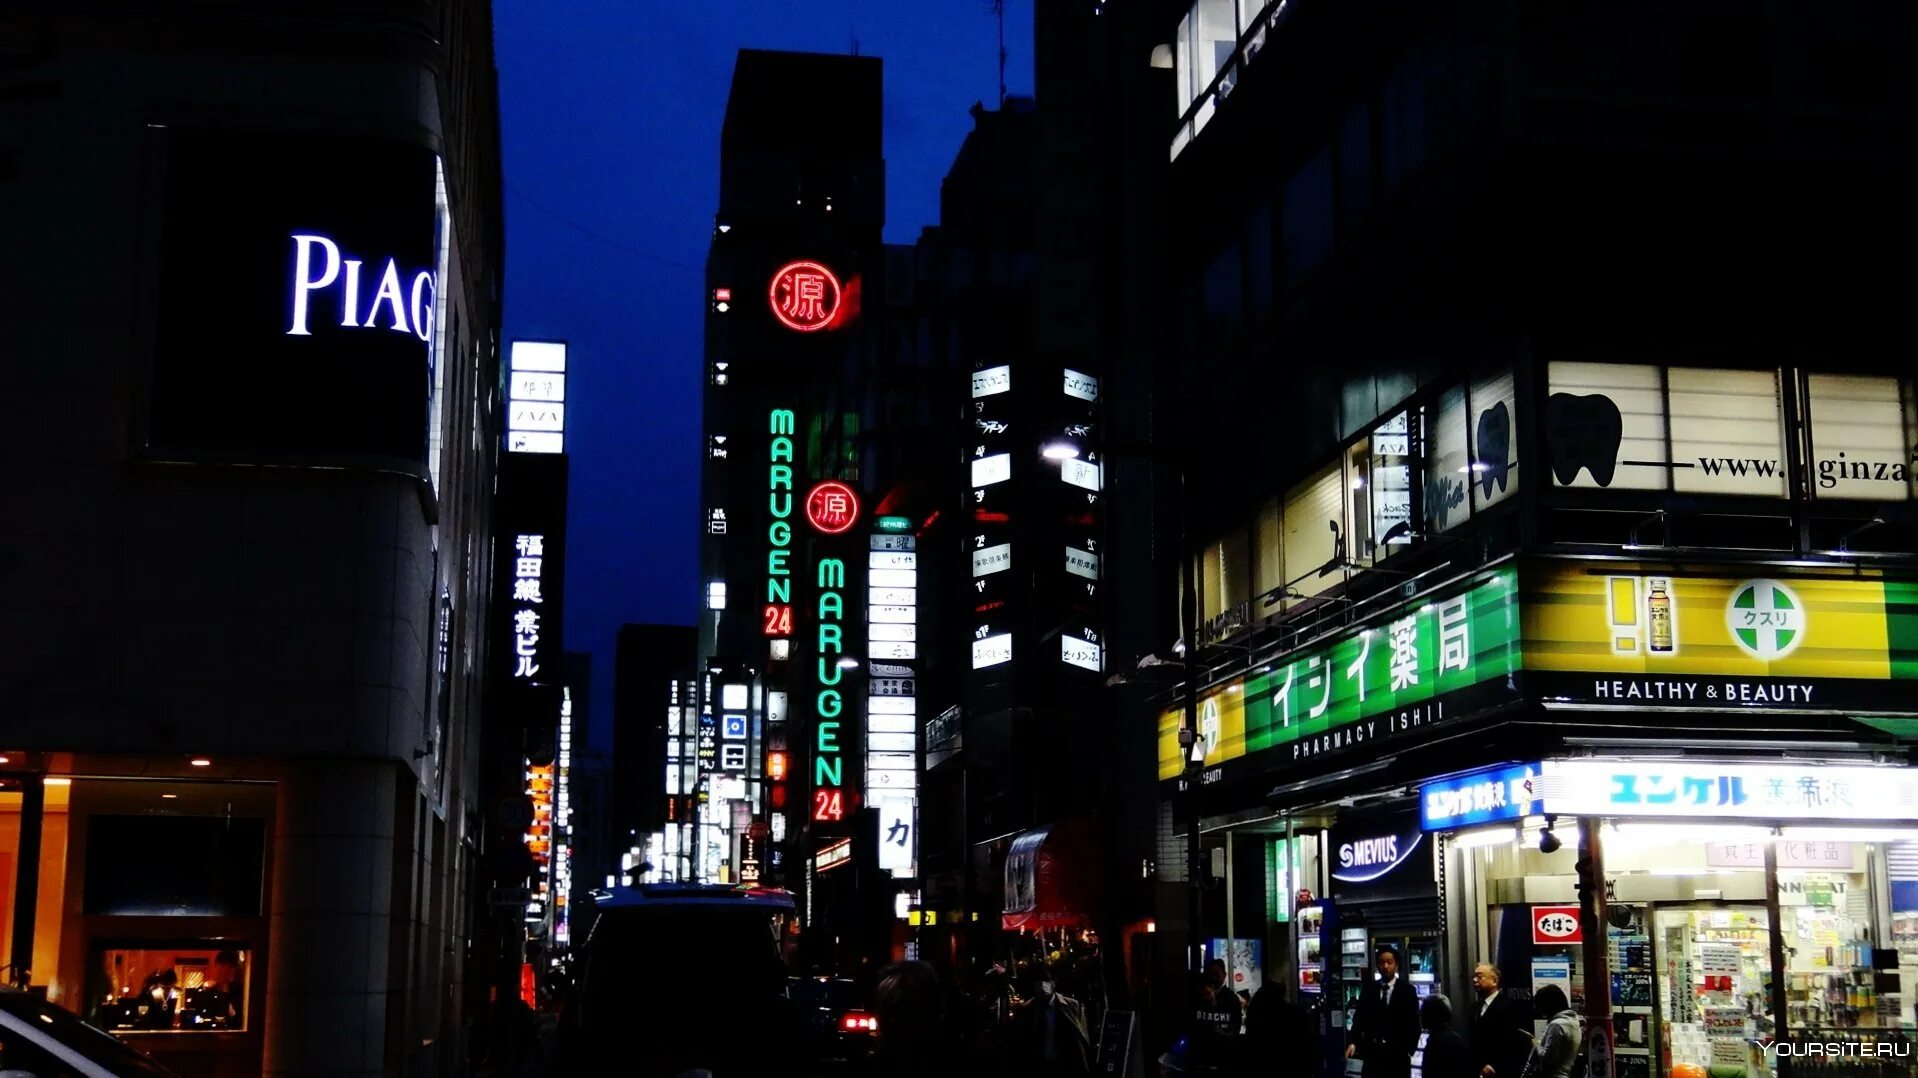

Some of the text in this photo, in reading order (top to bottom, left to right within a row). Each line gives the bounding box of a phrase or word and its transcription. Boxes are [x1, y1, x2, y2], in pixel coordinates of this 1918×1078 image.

[782, 273, 825, 320] 源
[1699, 457, 1785, 479] www.
[1819, 452, 1908, 489] ginza
[765, 409, 794, 634] MARUGEN 24
[815, 492, 848, 524] 源
[974, 534, 986, 548] 2F
[975, 580, 986, 593] 1F
[1743, 610, 1788, 627] クスリ
[816, 558, 844, 786] MARUGEN
[1273, 592, 1470, 728] イシイ薬局
[1595, 680, 1814, 702] HEALTHY & BEAUTY
[1293, 702, 1442, 760] PHARMACY ISHII
[815, 790, 842, 821] 24
[1609, 774, 1749, 806] ユンケル
[1353, 834, 1398, 867] MEVIUS
[1541, 916, 1574, 933] たばこ
